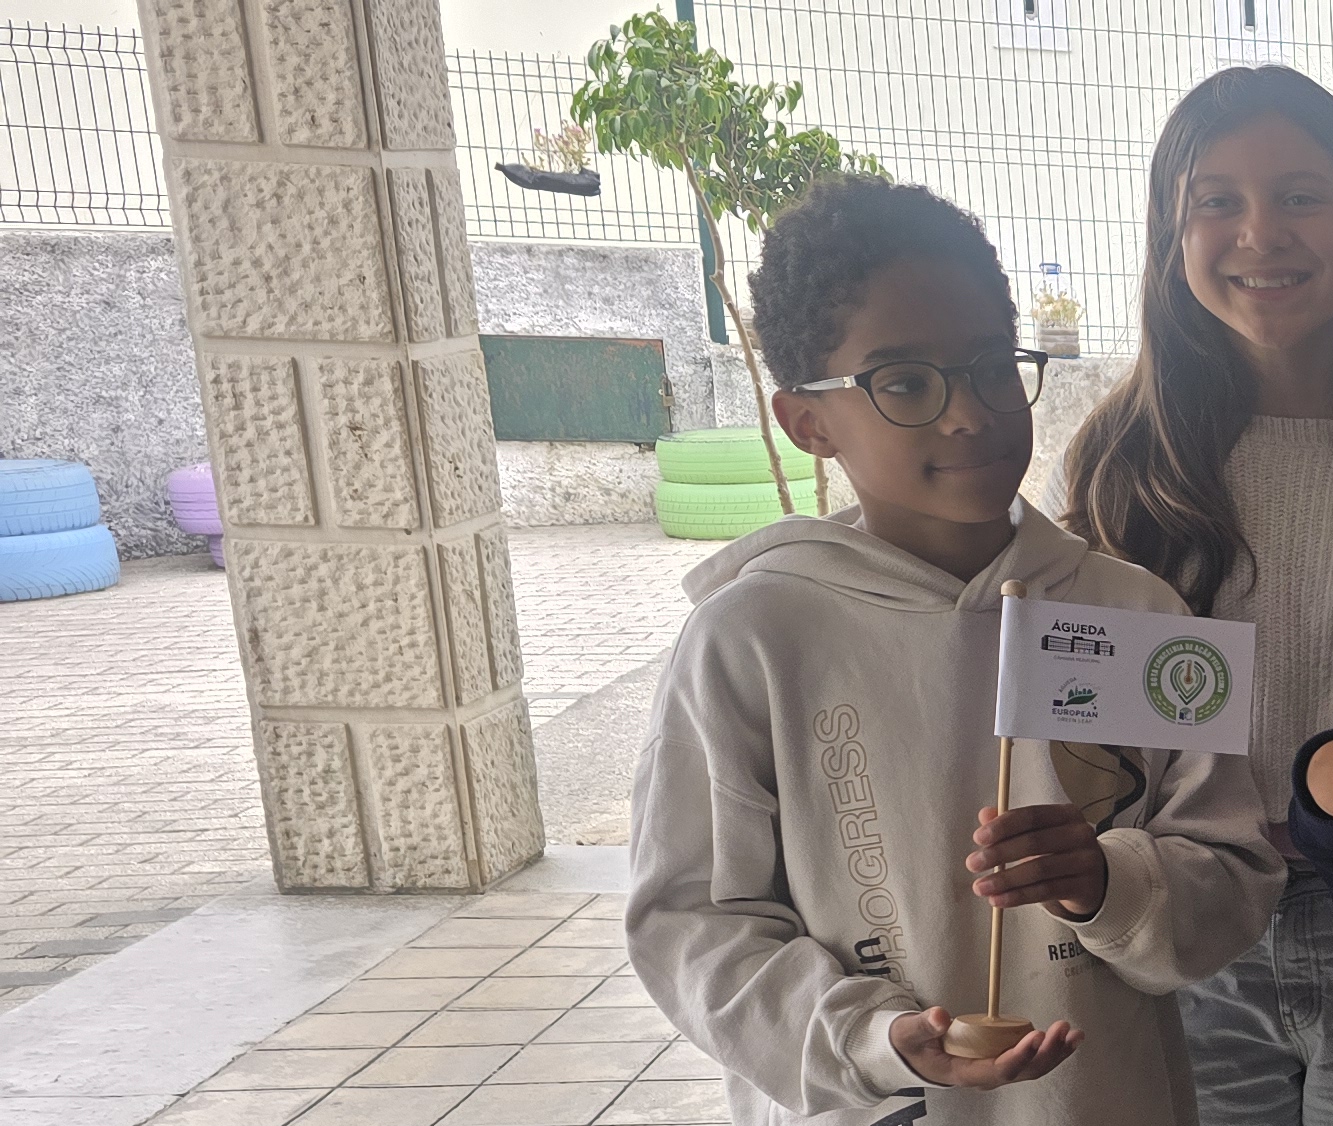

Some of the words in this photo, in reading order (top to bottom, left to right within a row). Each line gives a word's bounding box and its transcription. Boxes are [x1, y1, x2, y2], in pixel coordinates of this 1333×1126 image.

[1051, 619, 1107, 637] ÁGUEDA
[1052, 708, 1099, 718] EUROPEAN
[813, 703, 915, 992] PROGRESS
